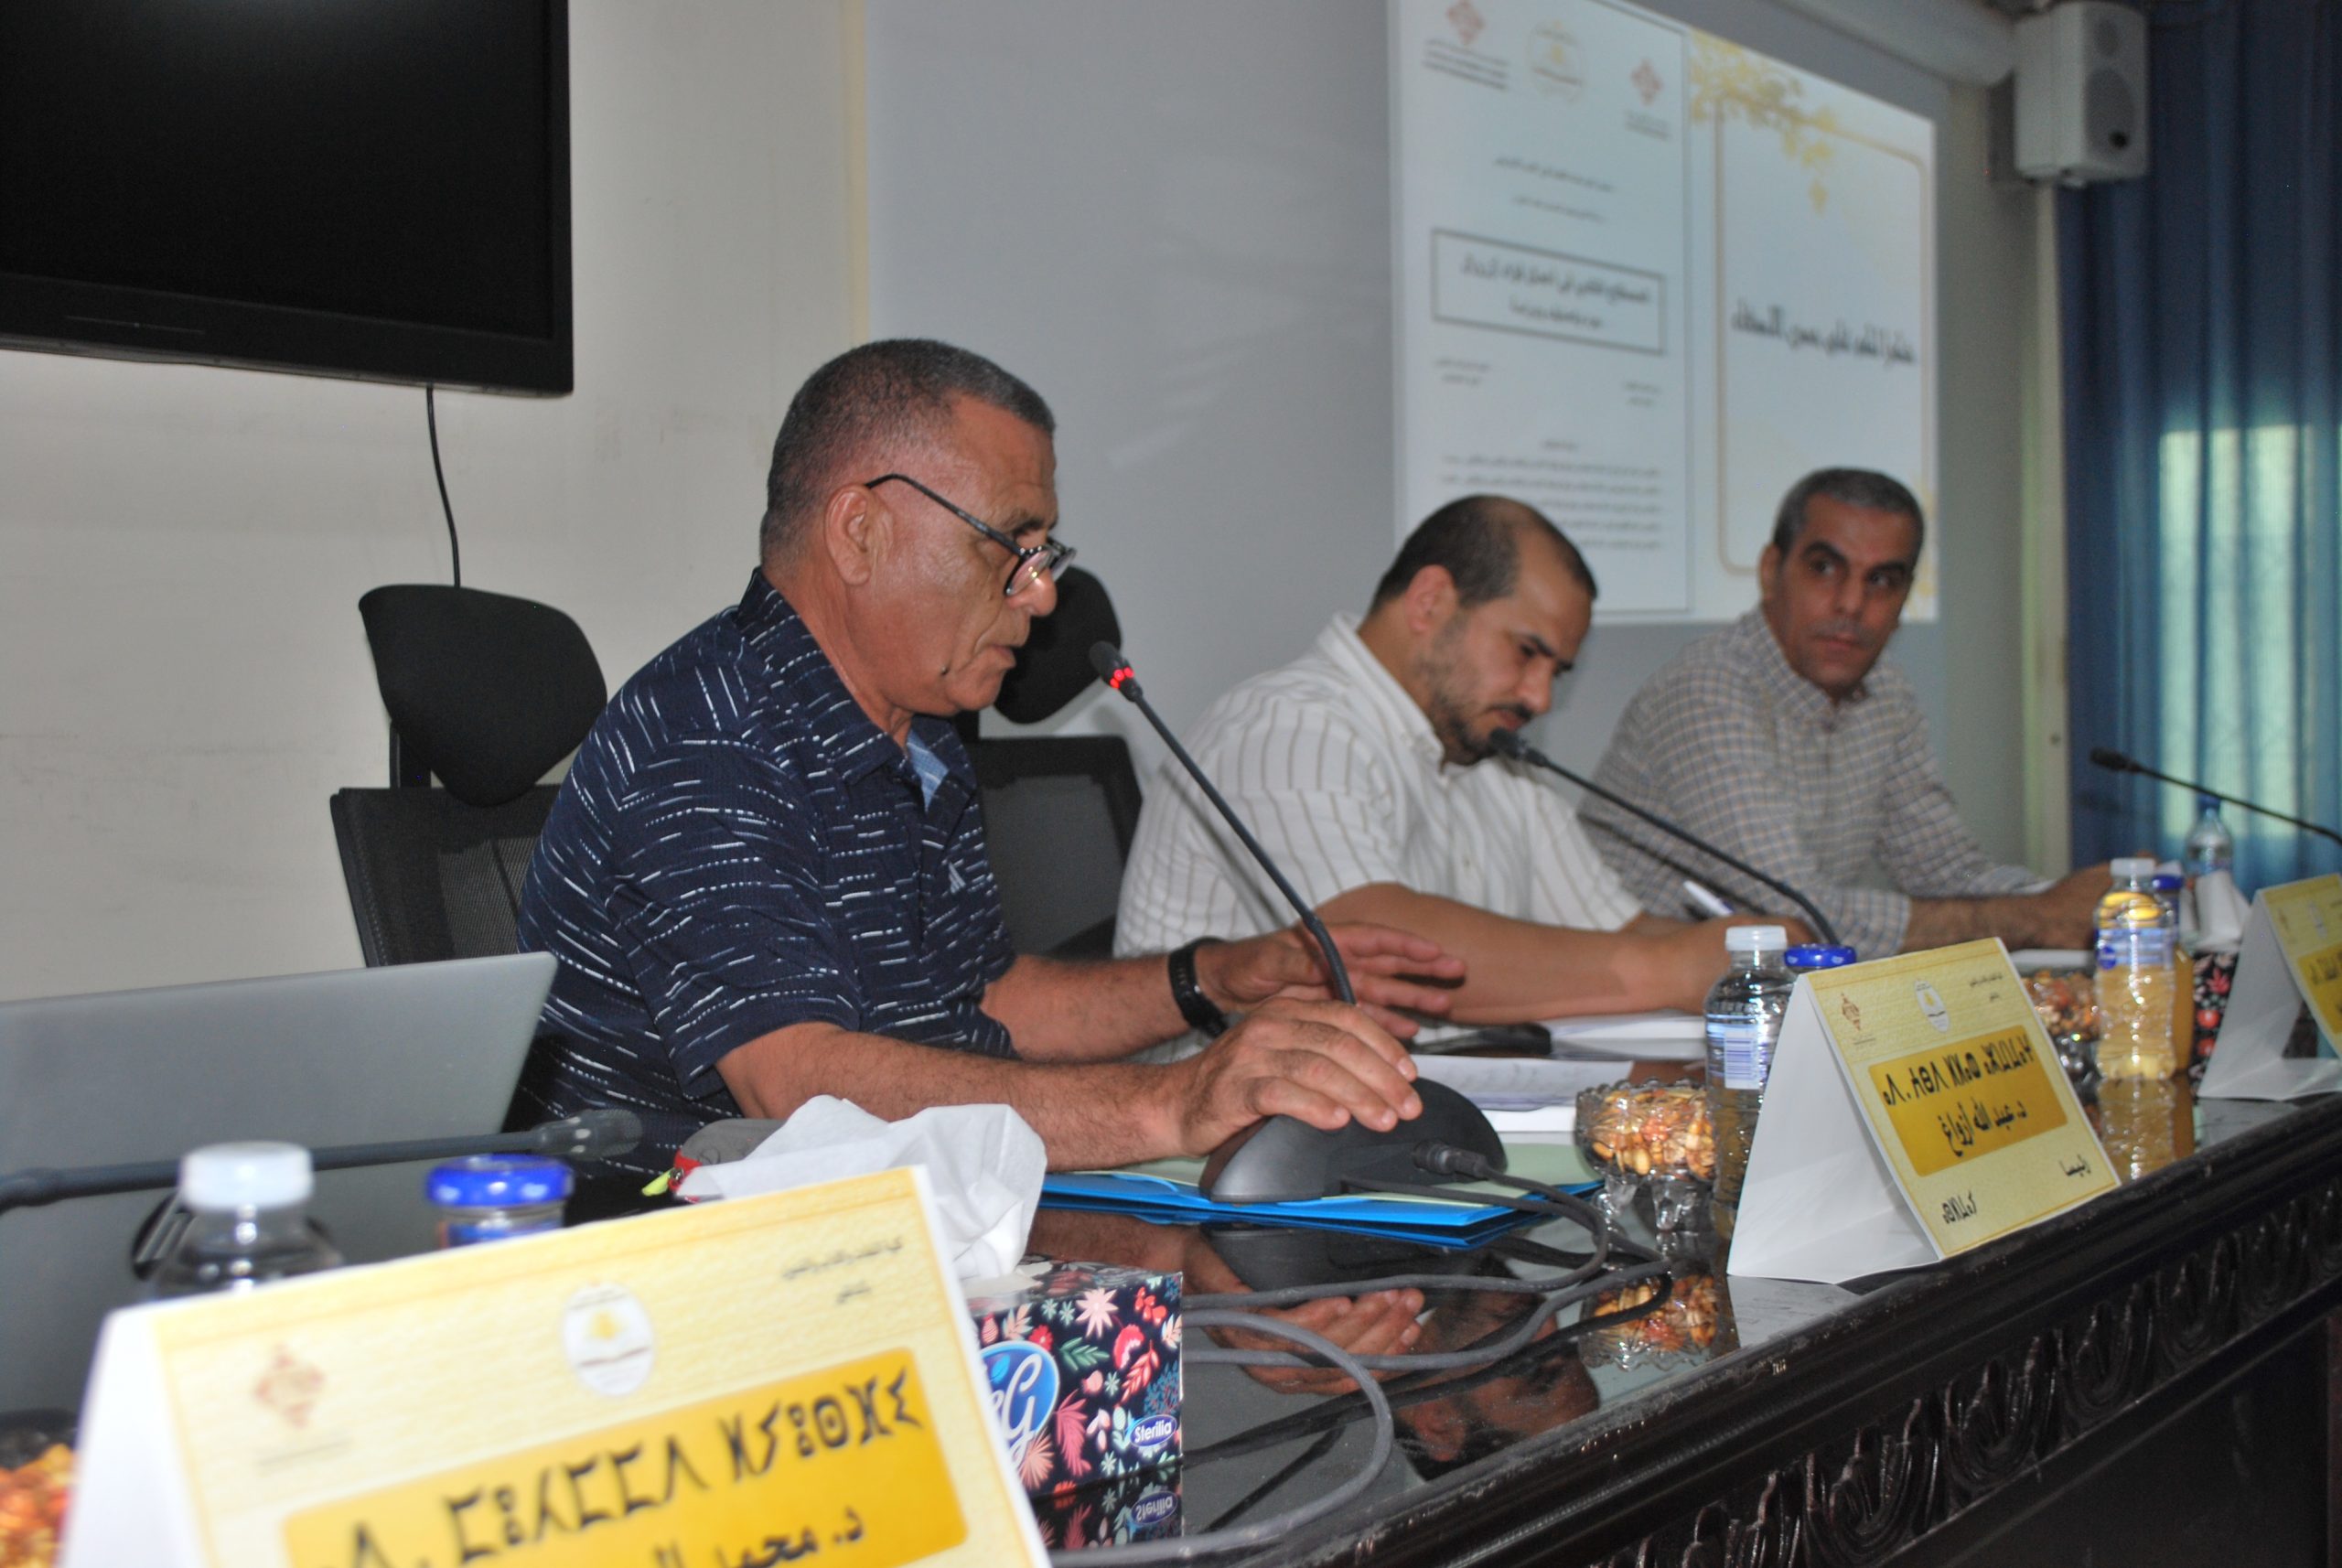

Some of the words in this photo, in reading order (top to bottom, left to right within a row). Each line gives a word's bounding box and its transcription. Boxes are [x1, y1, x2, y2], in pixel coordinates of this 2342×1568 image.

[1971, 1097, 1993, 1131] الله
[1993, 1105, 2014, 1131] عبد
[1134, 1420, 1172, 1444] Sterilia
